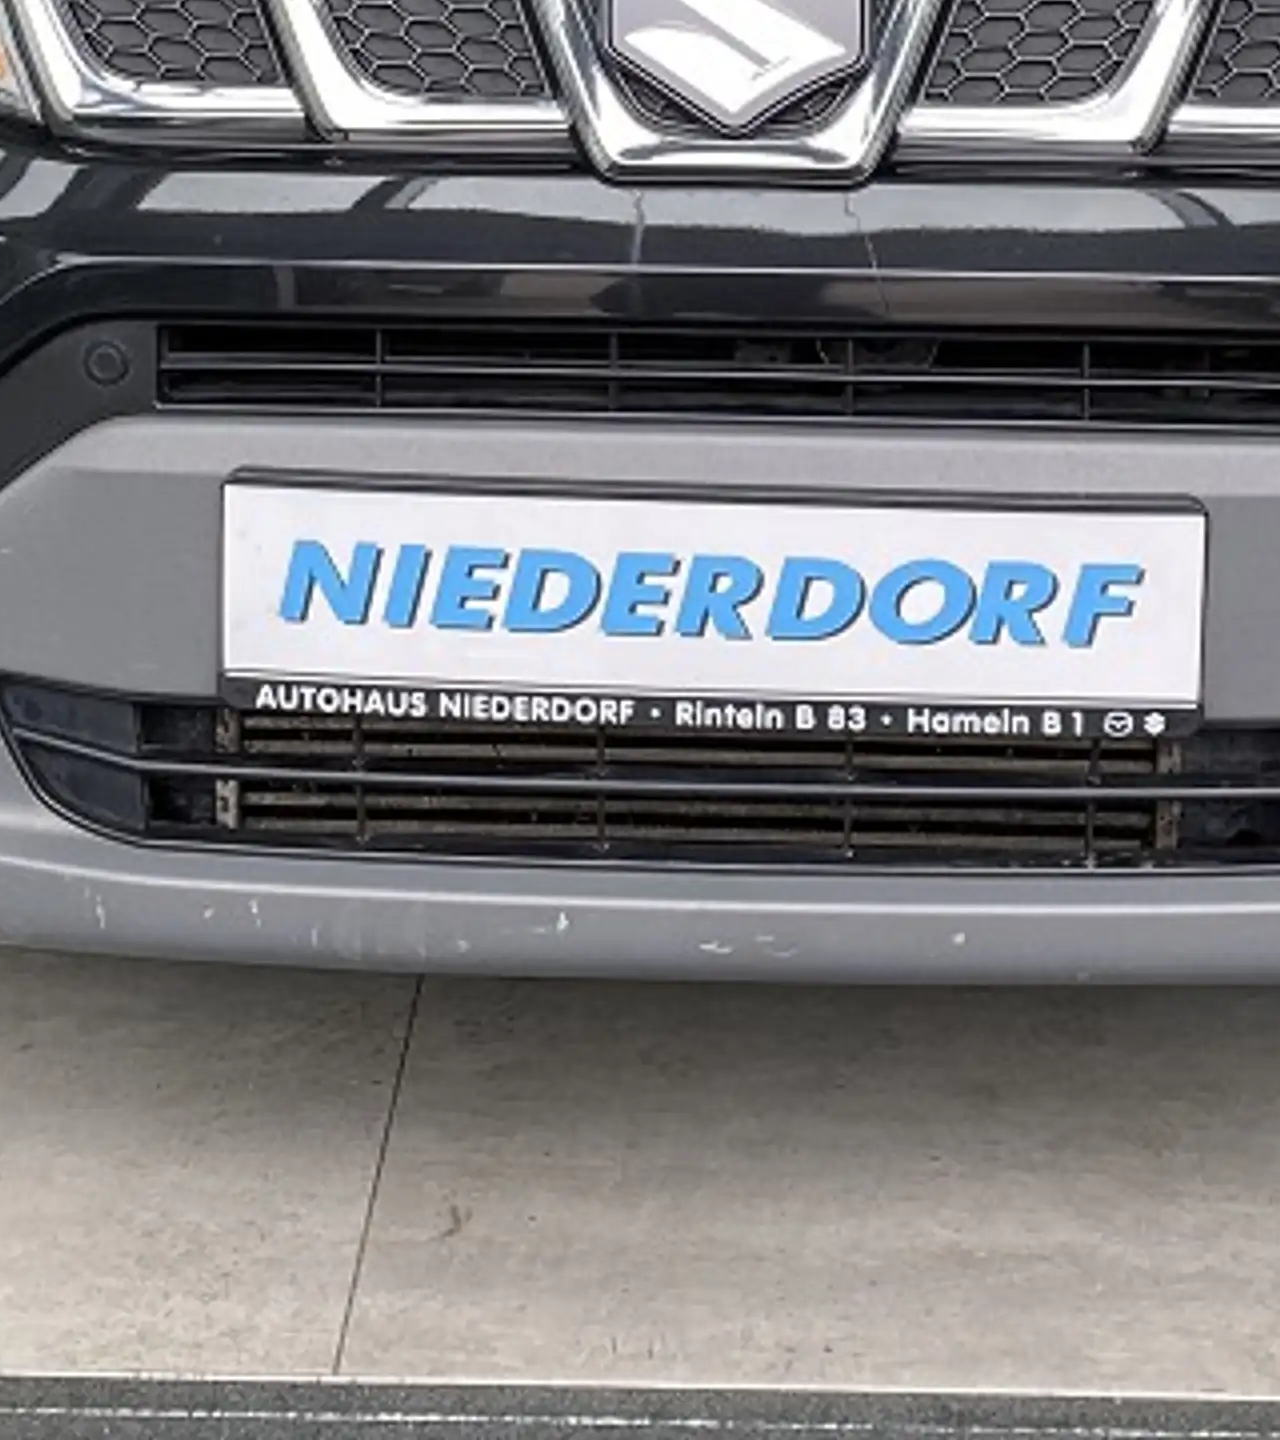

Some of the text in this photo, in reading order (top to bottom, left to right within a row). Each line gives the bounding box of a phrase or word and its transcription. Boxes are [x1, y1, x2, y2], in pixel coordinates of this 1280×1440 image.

[280, 540, 1144, 647] NIEDERDORF
[255, 683, 1084, 737] AUTOHAUS NIEDERDORF Rinteln B 83 Hameln B 1
